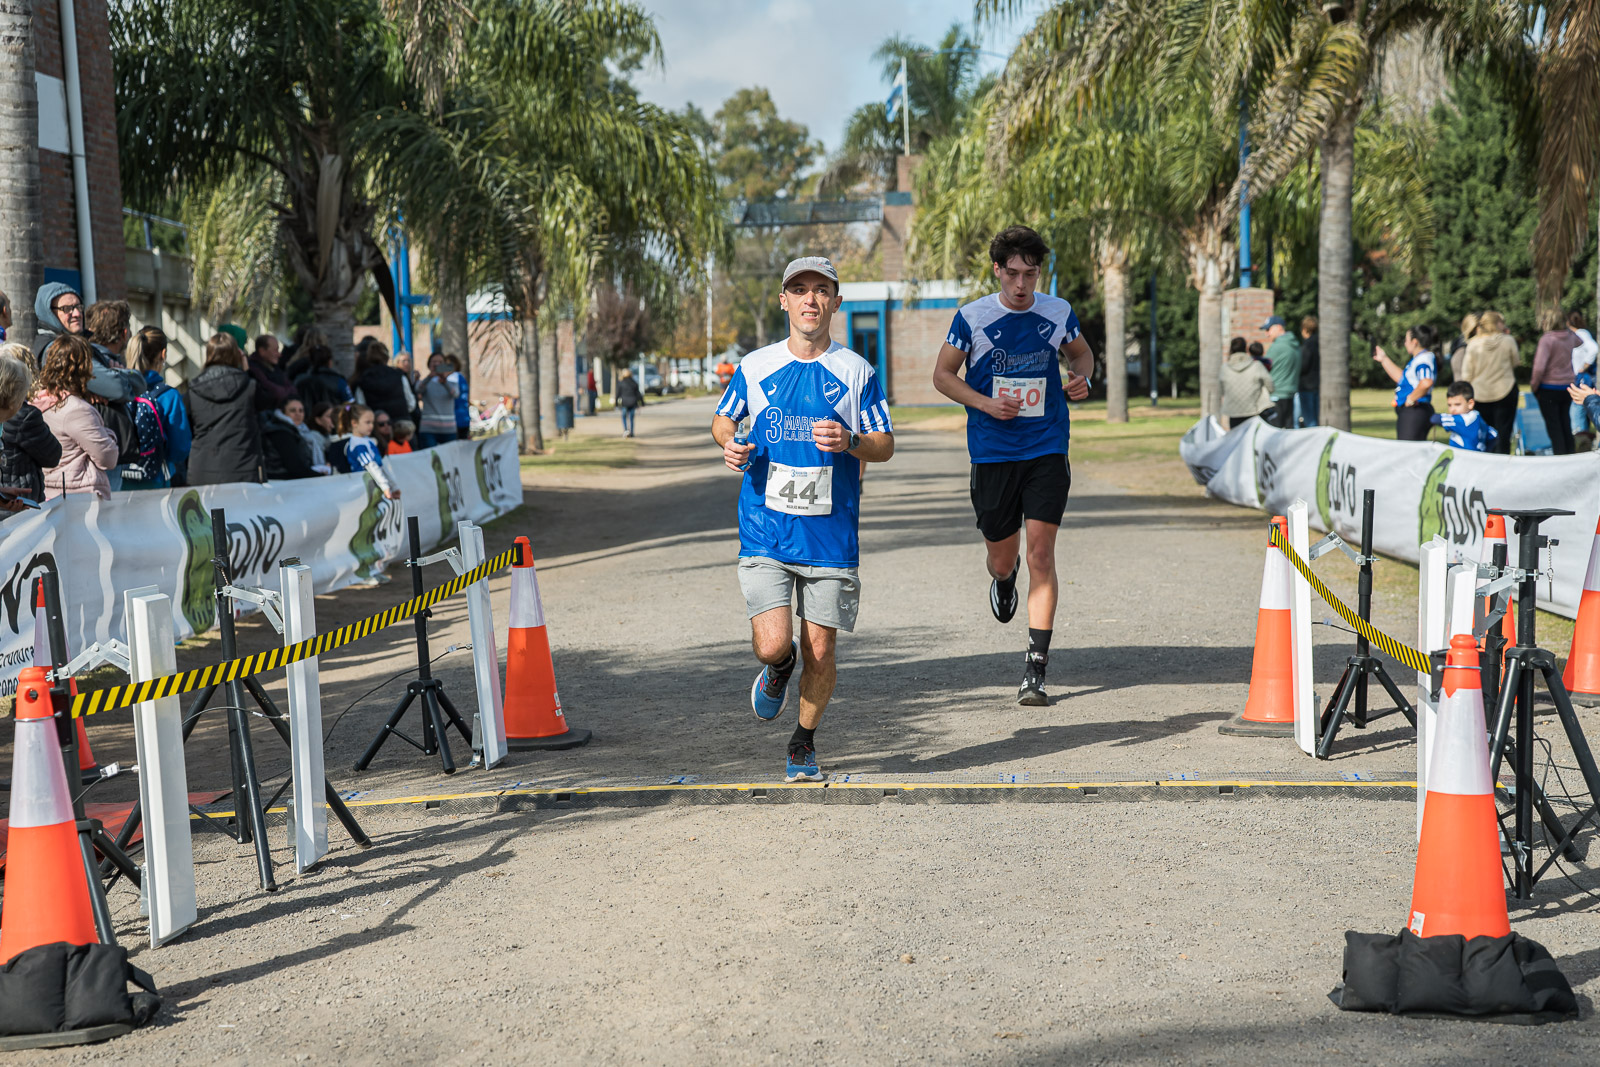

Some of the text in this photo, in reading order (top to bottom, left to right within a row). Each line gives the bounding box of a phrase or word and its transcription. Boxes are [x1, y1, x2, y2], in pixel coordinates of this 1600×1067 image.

[992, 348, 1006, 375] 3
[766, 407, 836, 443] 3 MARA
[779, 480, 819, 505] 44
